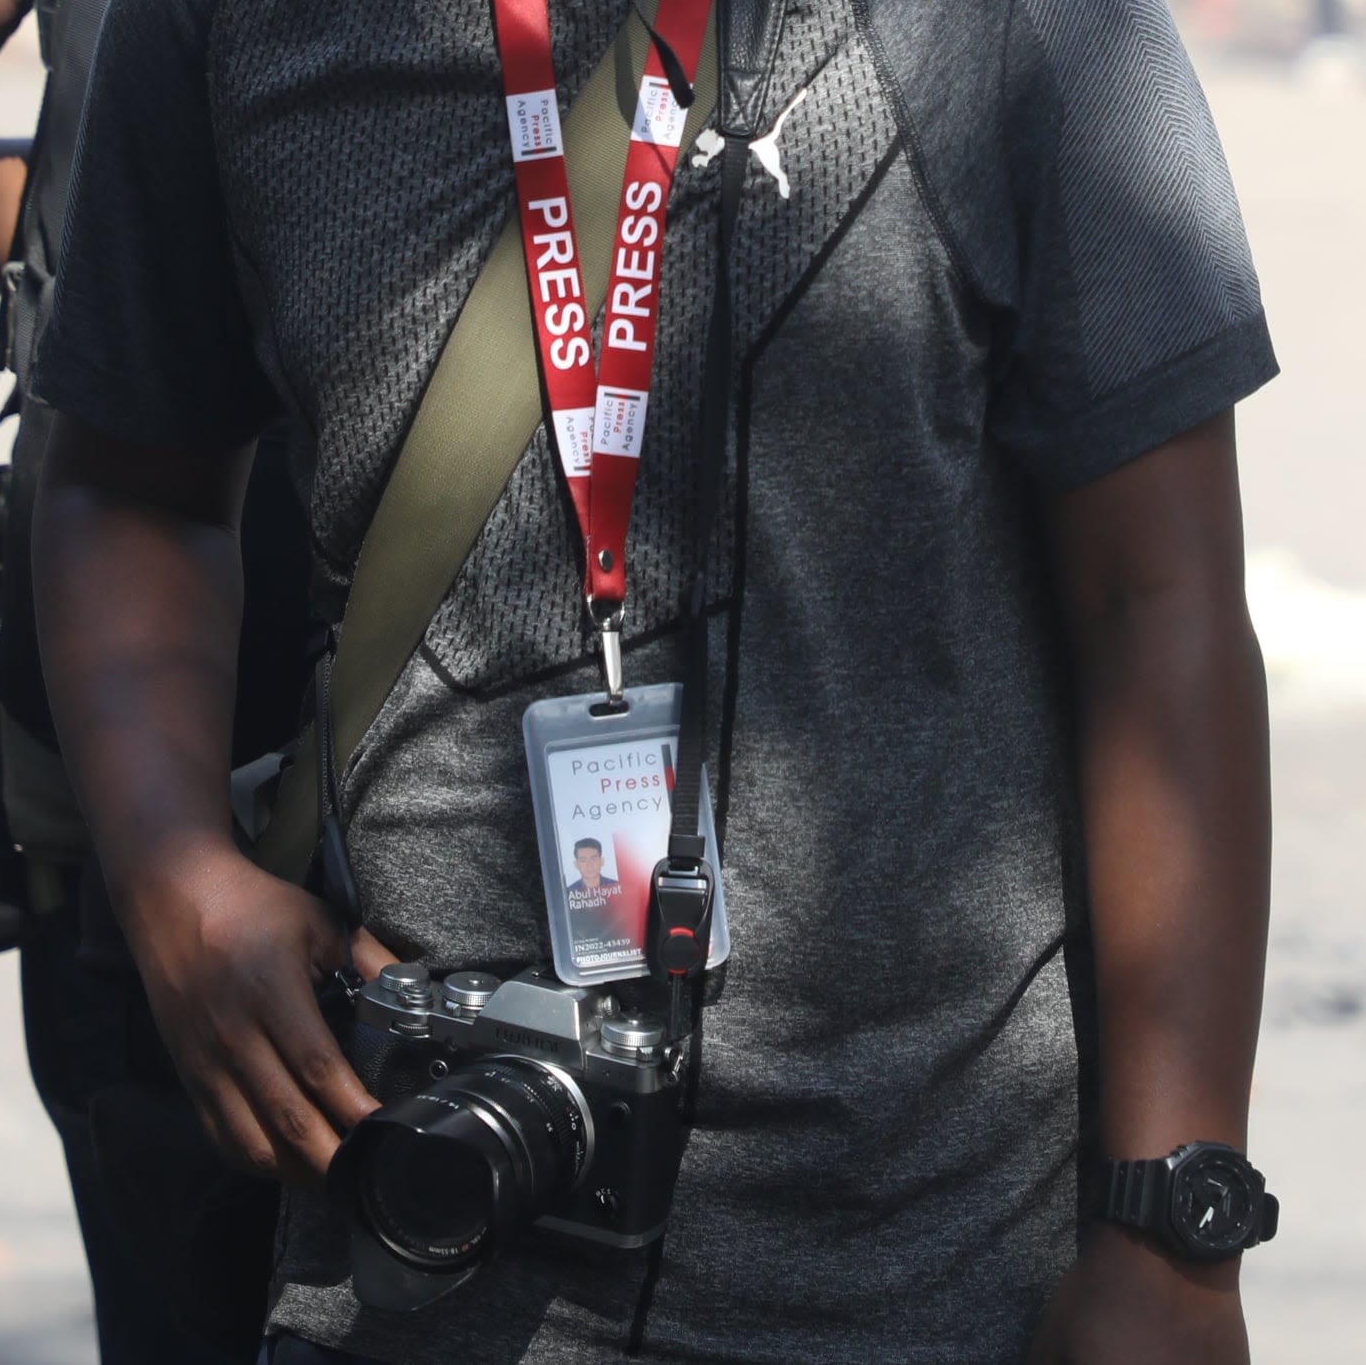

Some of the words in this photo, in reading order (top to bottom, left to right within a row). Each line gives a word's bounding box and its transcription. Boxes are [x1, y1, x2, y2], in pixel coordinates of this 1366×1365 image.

[540, 99, 553, 145] Pacific
[641, 90, 658, 134] Pacific
[655, 91, 670, 123] Press
[516, 99, 530, 148] Agency
[531, 115, 542, 147] Press
[608, 181, 662, 352] PRESS
[528, 196, 589, 370] PRESS
[601, 399, 614, 445] Pacific
[613, 402, 625, 434] Press
[622, 403, 638, 451] Agency
[566, 416, 581, 464] Agency
[572, 752, 657, 775] Pacific
[600, 774, 660, 794] Press
[572, 795, 661, 820] Agency
[569, 888, 591, 900] Abul
[594, 885, 622, 898] Hayat
[570, 897, 606, 910] Rahadh
[576, 948, 642, 963] PHOTOJOURNALIST
